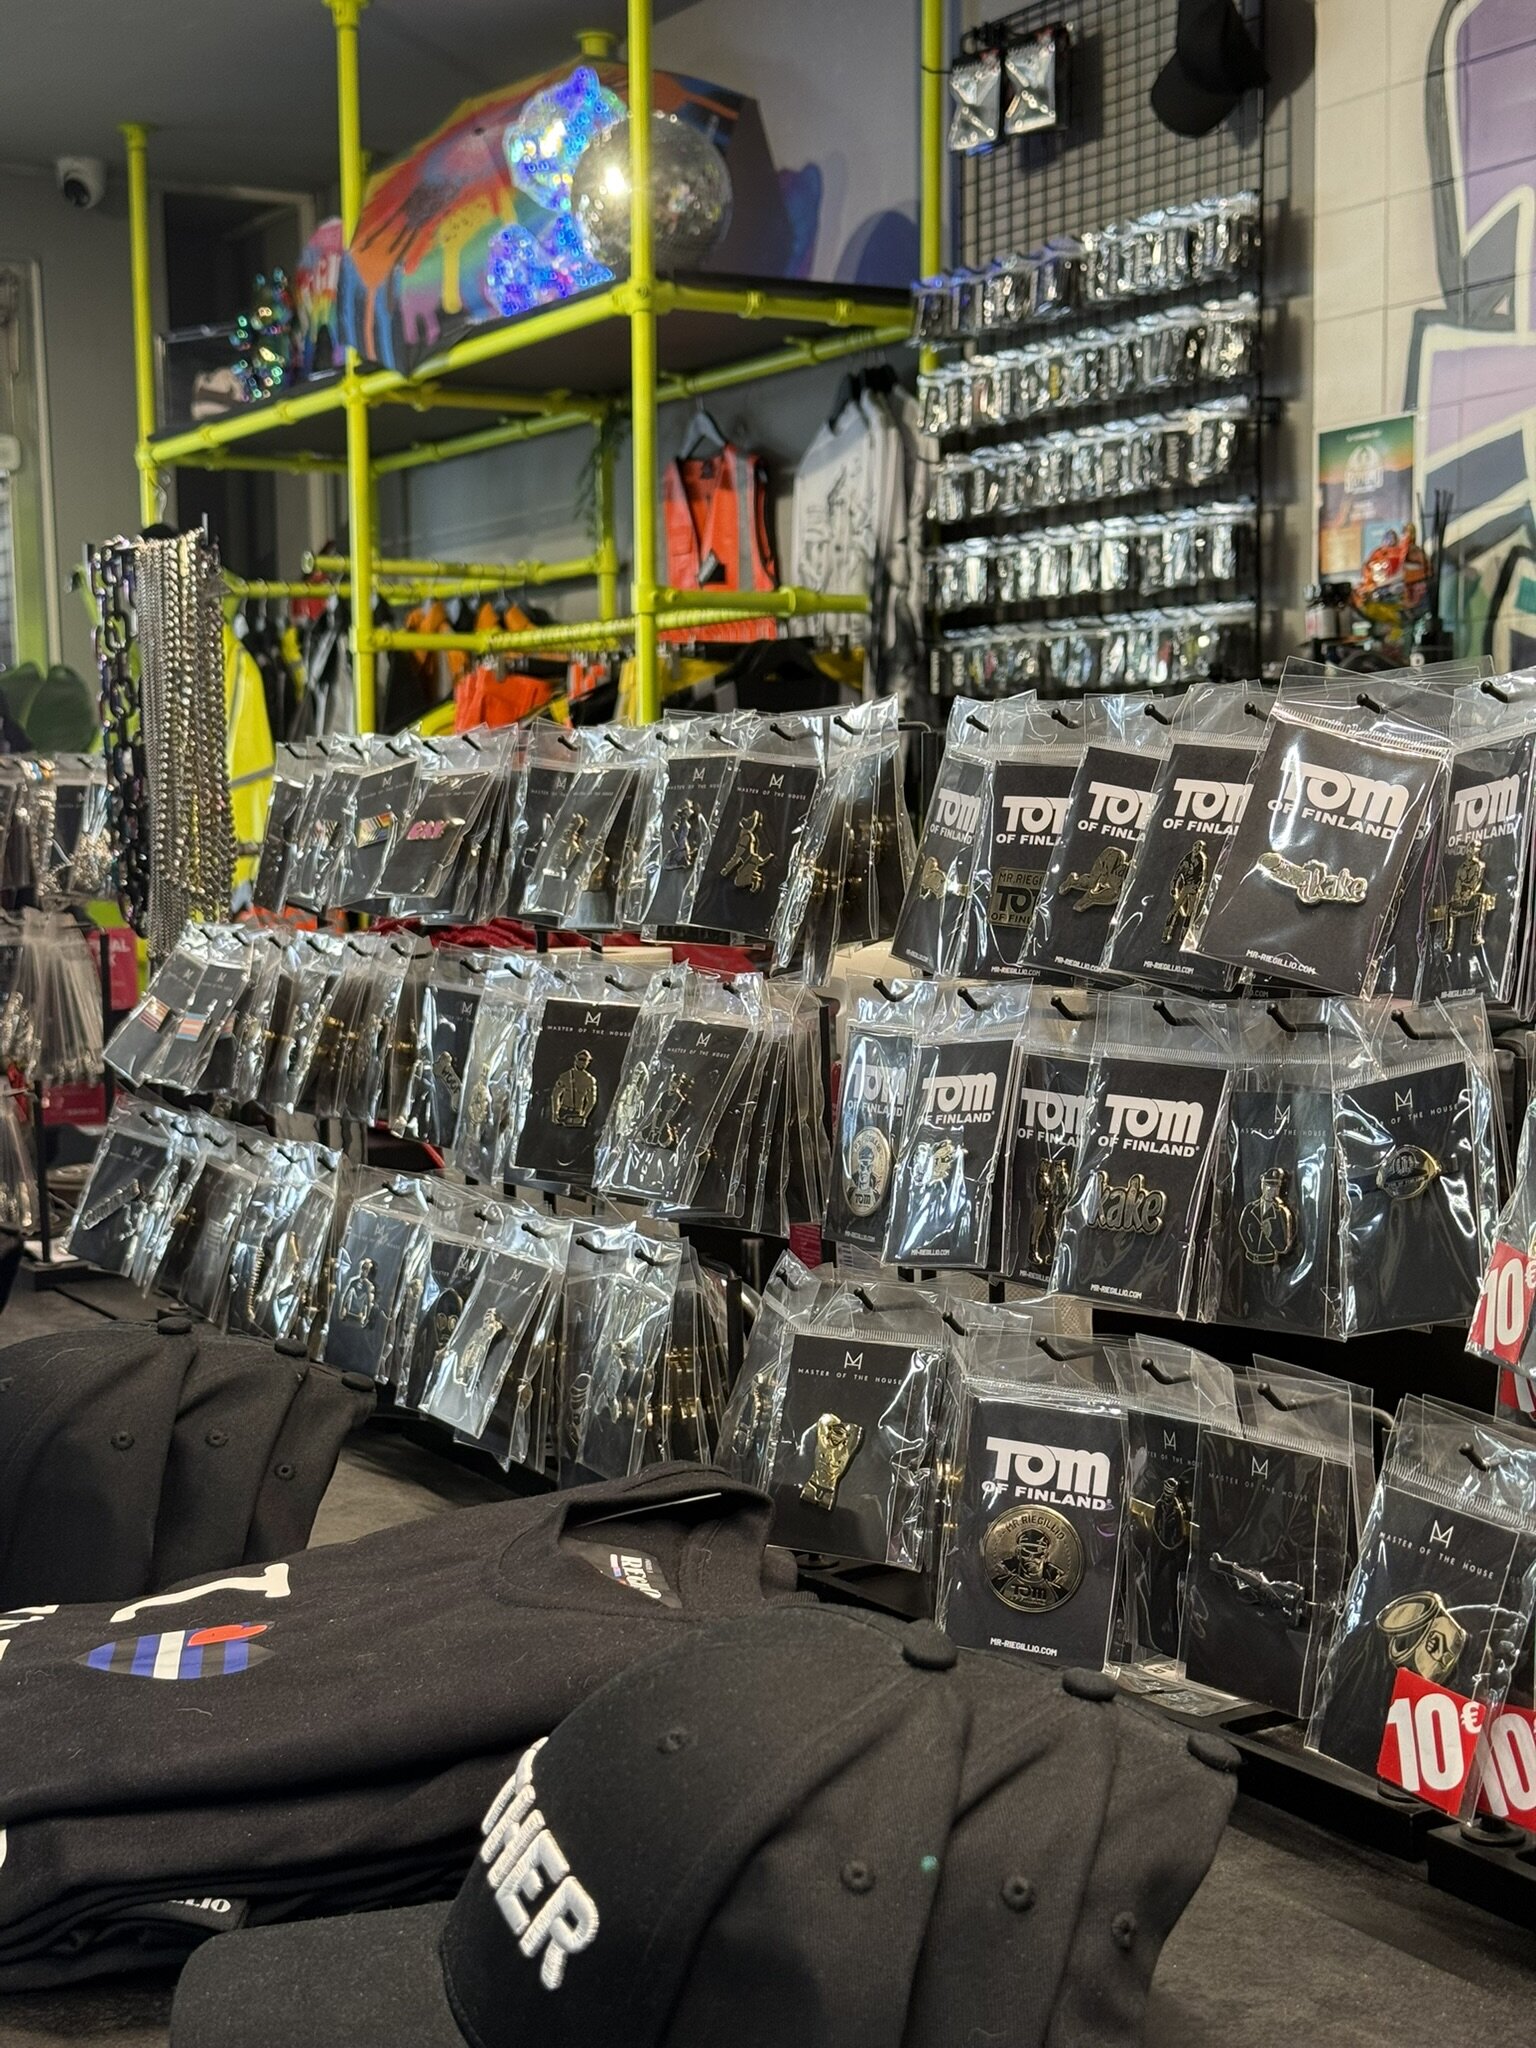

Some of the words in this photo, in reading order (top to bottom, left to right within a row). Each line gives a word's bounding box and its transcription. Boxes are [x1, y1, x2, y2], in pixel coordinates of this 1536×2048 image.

[1280, 757, 1410, 828] TOM
[1454, 774, 1521, 832] TOM
[937, 788, 981, 833] TOM
[1162, 818, 1184, 829] OF
[1267, 799, 1298, 815] OF
[1300, 809, 1396, 840] FINLAND
[929, 824, 938, 833] OF
[939, 826, 974, 845] FINLAND
[1077, 820, 1099, 831] OF
[1447, 833, 1463, 848] OF
[1465, 822, 1515, 844] FINLAND
[996, 834, 1015, 844] OF
[997, 885, 1040, 913] TO
[1246, 949, 1316, 975] MR-RIEGILLIO.COM
[852, 1064, 907, 1106] TOM
[921, 1072, 997, 1113] TOM
[935, 1112, 991, 1125] FINLAND
[1105, 1094, 1204, 1144] TOM
[1391, 1117, 1402, 1125] OF
[1408, 1112, 1423, 1120] THE
[1430, 1103, 1458, 1116] HOUSE
[1017, 1127, 1034, 1139] OF
[1097, 1136, 1120, 1148] OF
[1122, 1138, 1196, 1158] FINLAND
[797, 1368, 830, 1377] MASTER
[836, 1371, 847, 1379] OF
[854, 1374, 868, 1382] THE
[875, 1377, 903, 1386] HOUSE
[986, 1436, 1111, 1498] TOM
[981, 1480, 1008, 1494] OF
[1014, 1486, 1107, 1511] FINLAND
[1378, 1531, 1414, 1550] MASTER
[1419, 1545, 1432, 1557] OF
[1438, 1553, 1456, 1566] THE
[1462, 1560, 1495, 1581] HOUSE
[990, 1637, 1058, 1656] MR-RIEGILLIO.COM
